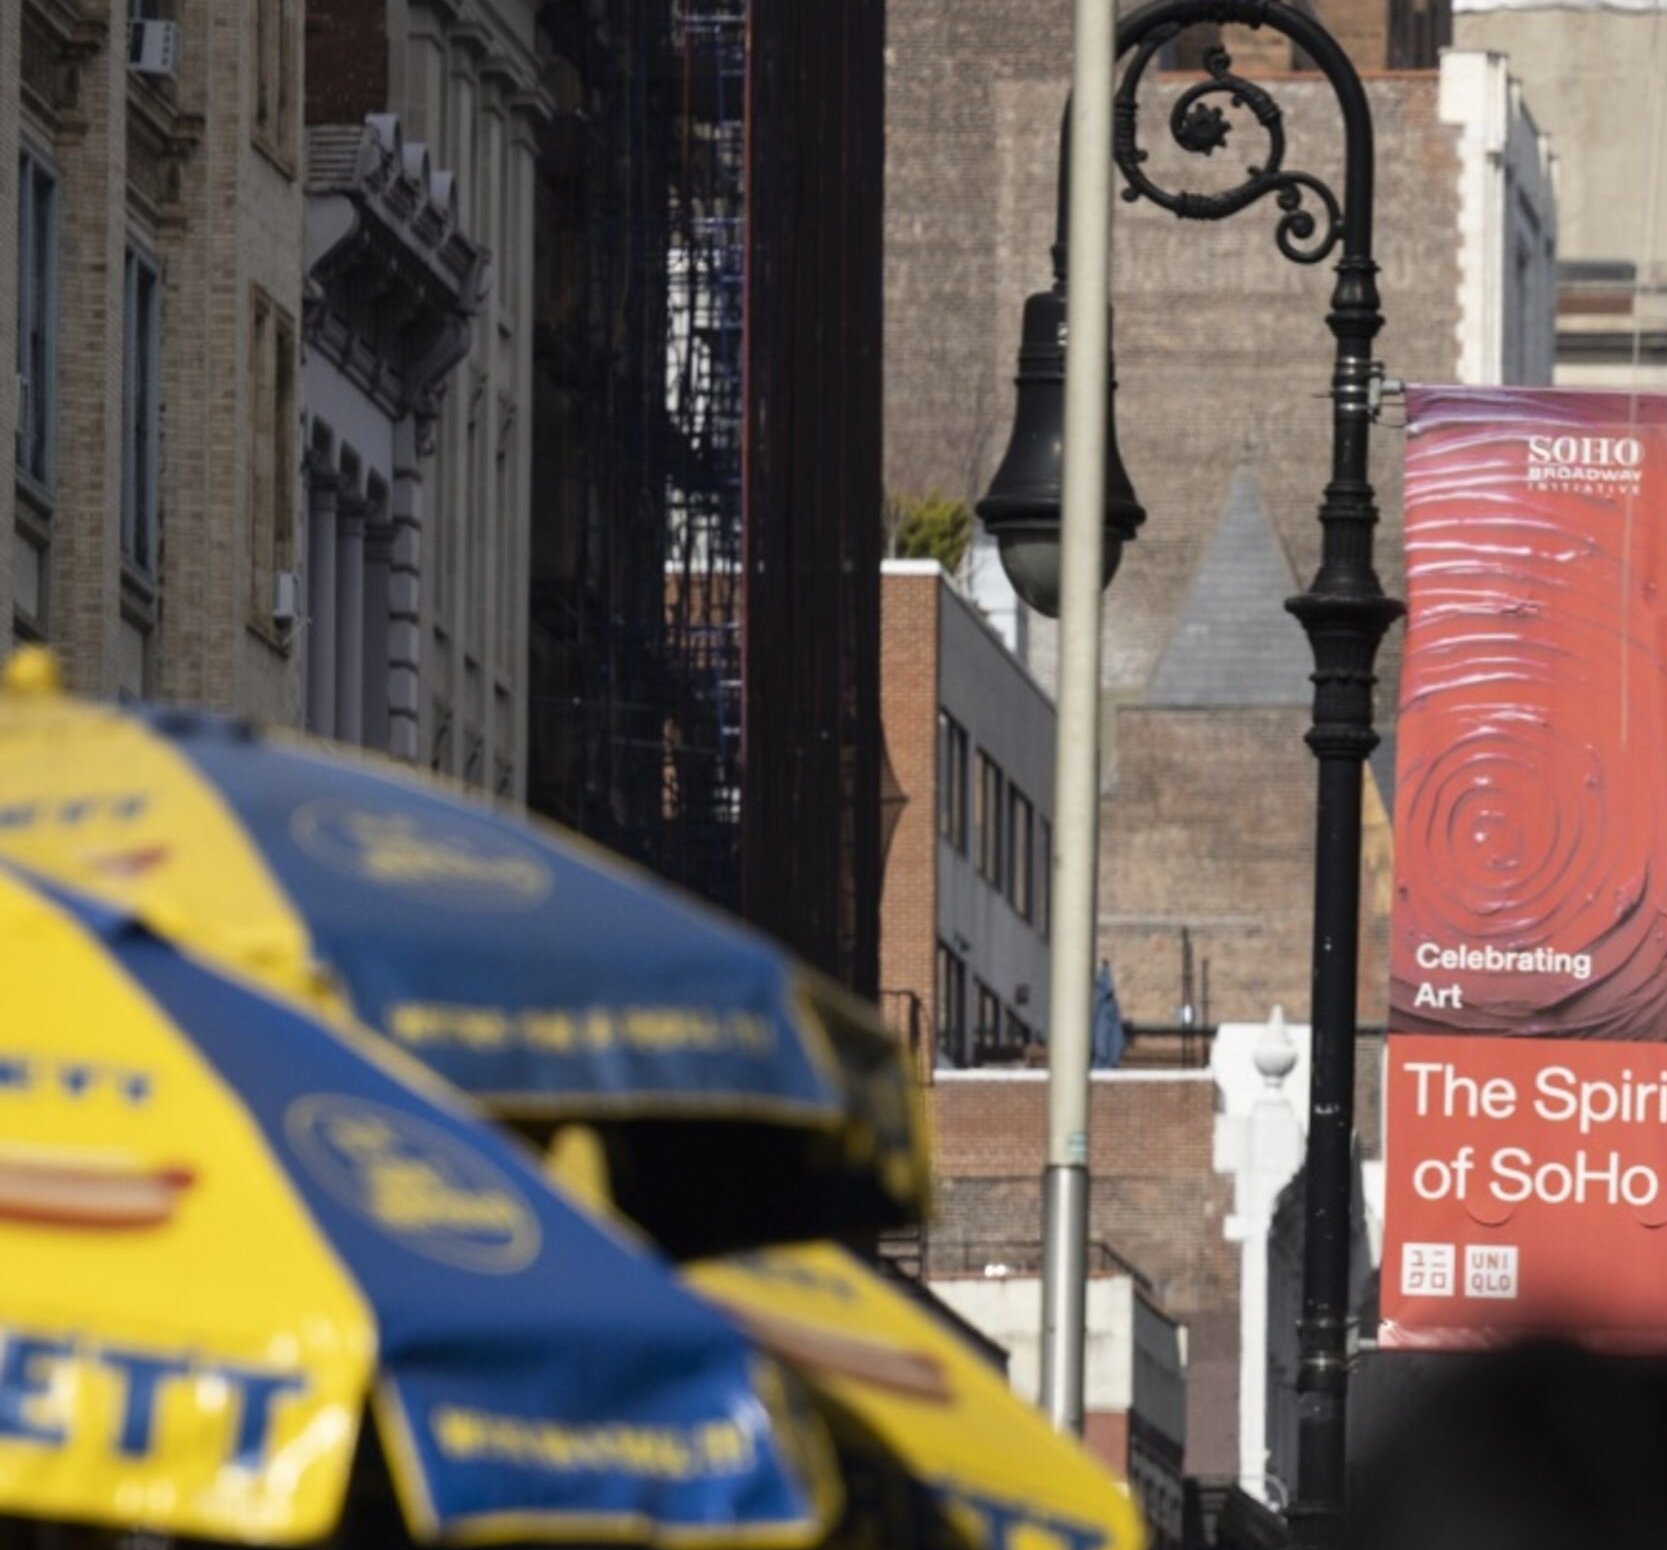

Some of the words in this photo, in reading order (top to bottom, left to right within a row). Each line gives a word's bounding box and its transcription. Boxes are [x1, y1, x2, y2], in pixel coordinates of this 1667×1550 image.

[1529, 435, 1643, 466] SOHO
[1528, 466, 1643, 482] BROADWAY
[1415, 942, 1593, 979] Celebrating
[1413, 982, 1463, 1009] Art
[1403, 1061, 1518, 1119] The
[1412, 1146, 1475, 1200] of
[1488, 1146, 1659, 1207] SoHo
[1471, 1252, 1510, 1271] UNI
[1471, 1272, 1512, 1294] QLO
